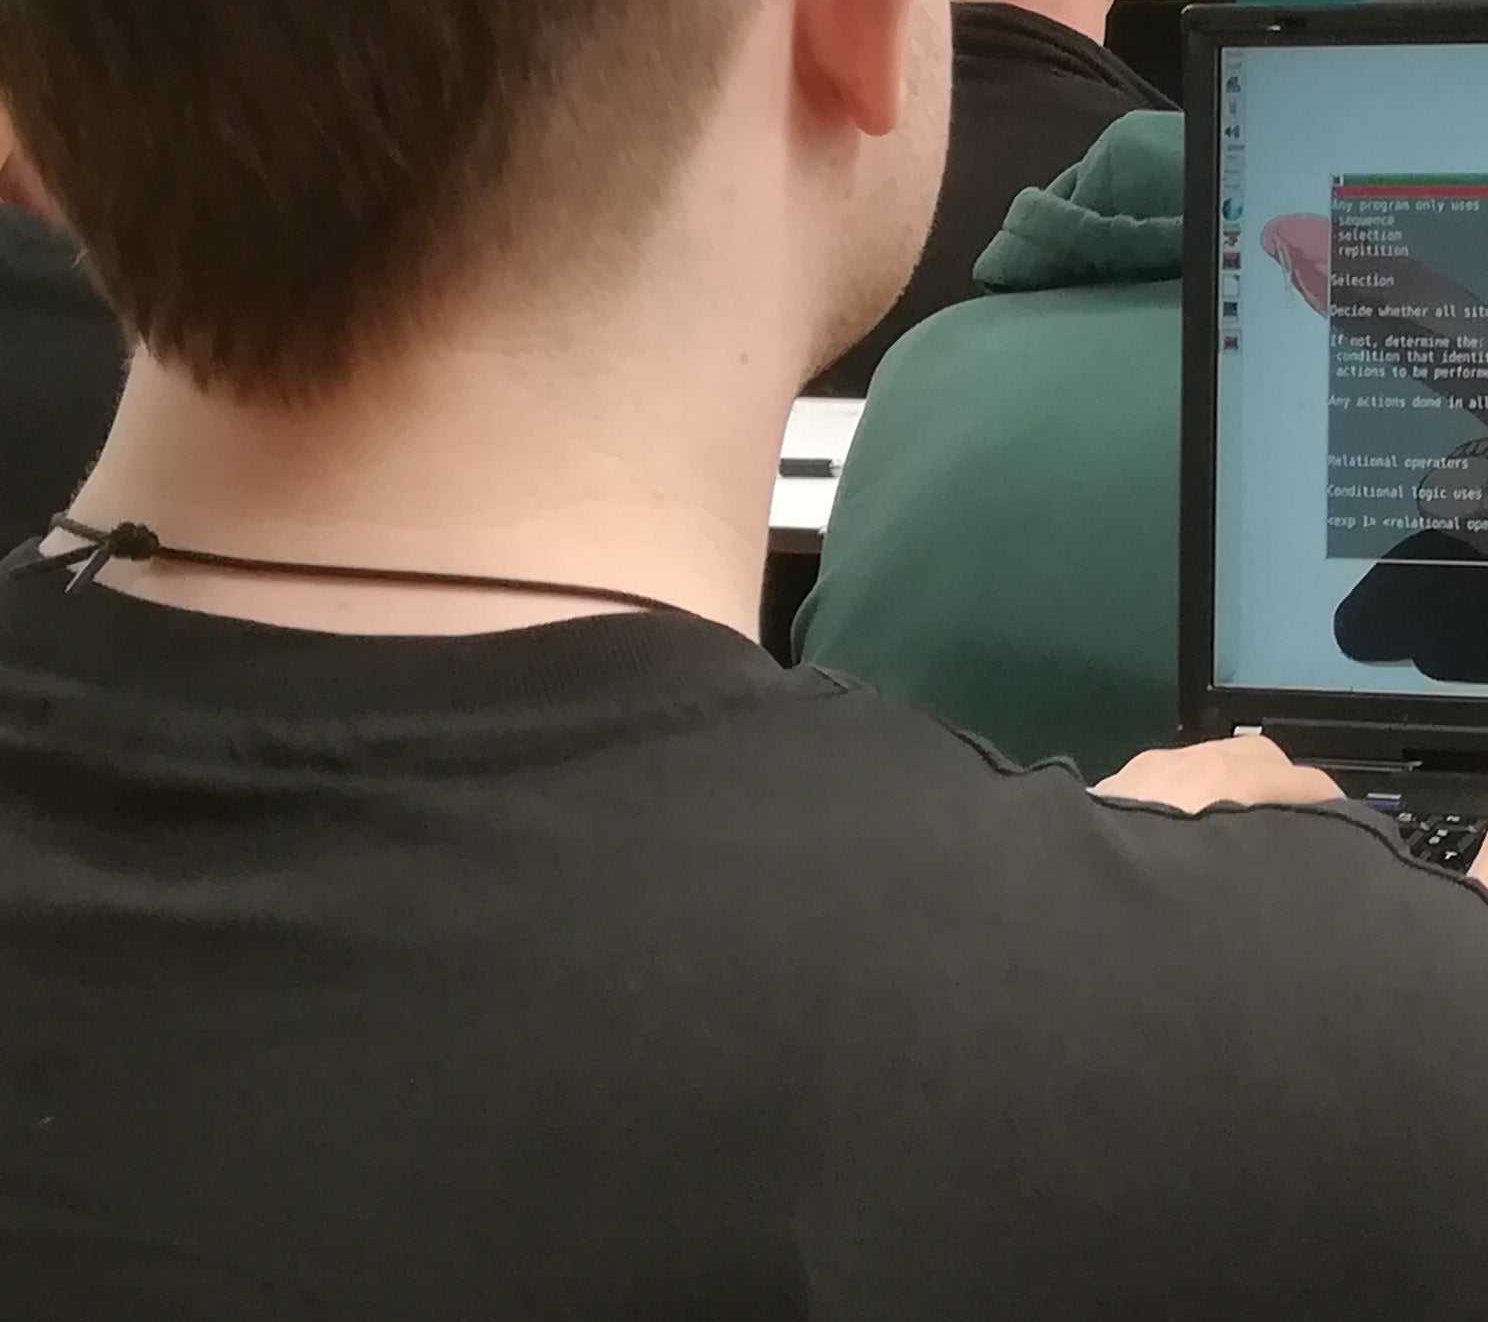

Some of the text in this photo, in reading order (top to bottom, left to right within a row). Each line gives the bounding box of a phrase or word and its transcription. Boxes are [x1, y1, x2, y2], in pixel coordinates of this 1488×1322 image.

[1333, 199, 1480, 214] Any program only uses
[1338, 215, 1396, 228] sequence
[1338, 230, 1402, 243] selection
[1330, 274, 1395, 287] Selection
[1329, 304, 1372, 318] Decide
[1378, 304, 1428, 318] whether
[1435, 305, 1457, 318] all
[1350, 334, 1378, 350] not,
[1384, 334, 1451, 349] determine
[1336, 349, 1400, 363] condition
[1406, 350, 1434, 364] that
[1335, 365, 1386, 378] actions
[1391, 365, 1407, 378] to
[1412, 365, 1428, 378] be
[1327, 395, 1352, 409] Any
[1356, 395, 1406, 409] actions
[1412, 396, 1441, 409] done
[1449, 396, 1464, 409] in
[1327, 454, 1398, 469] Relational
[1327, 484, 1404, 499] Conditional
[1411, 485, 1447, 501] logic
[1453, 488, 1483, 501] uses
[1382, 515, 1460, 530] <relational
